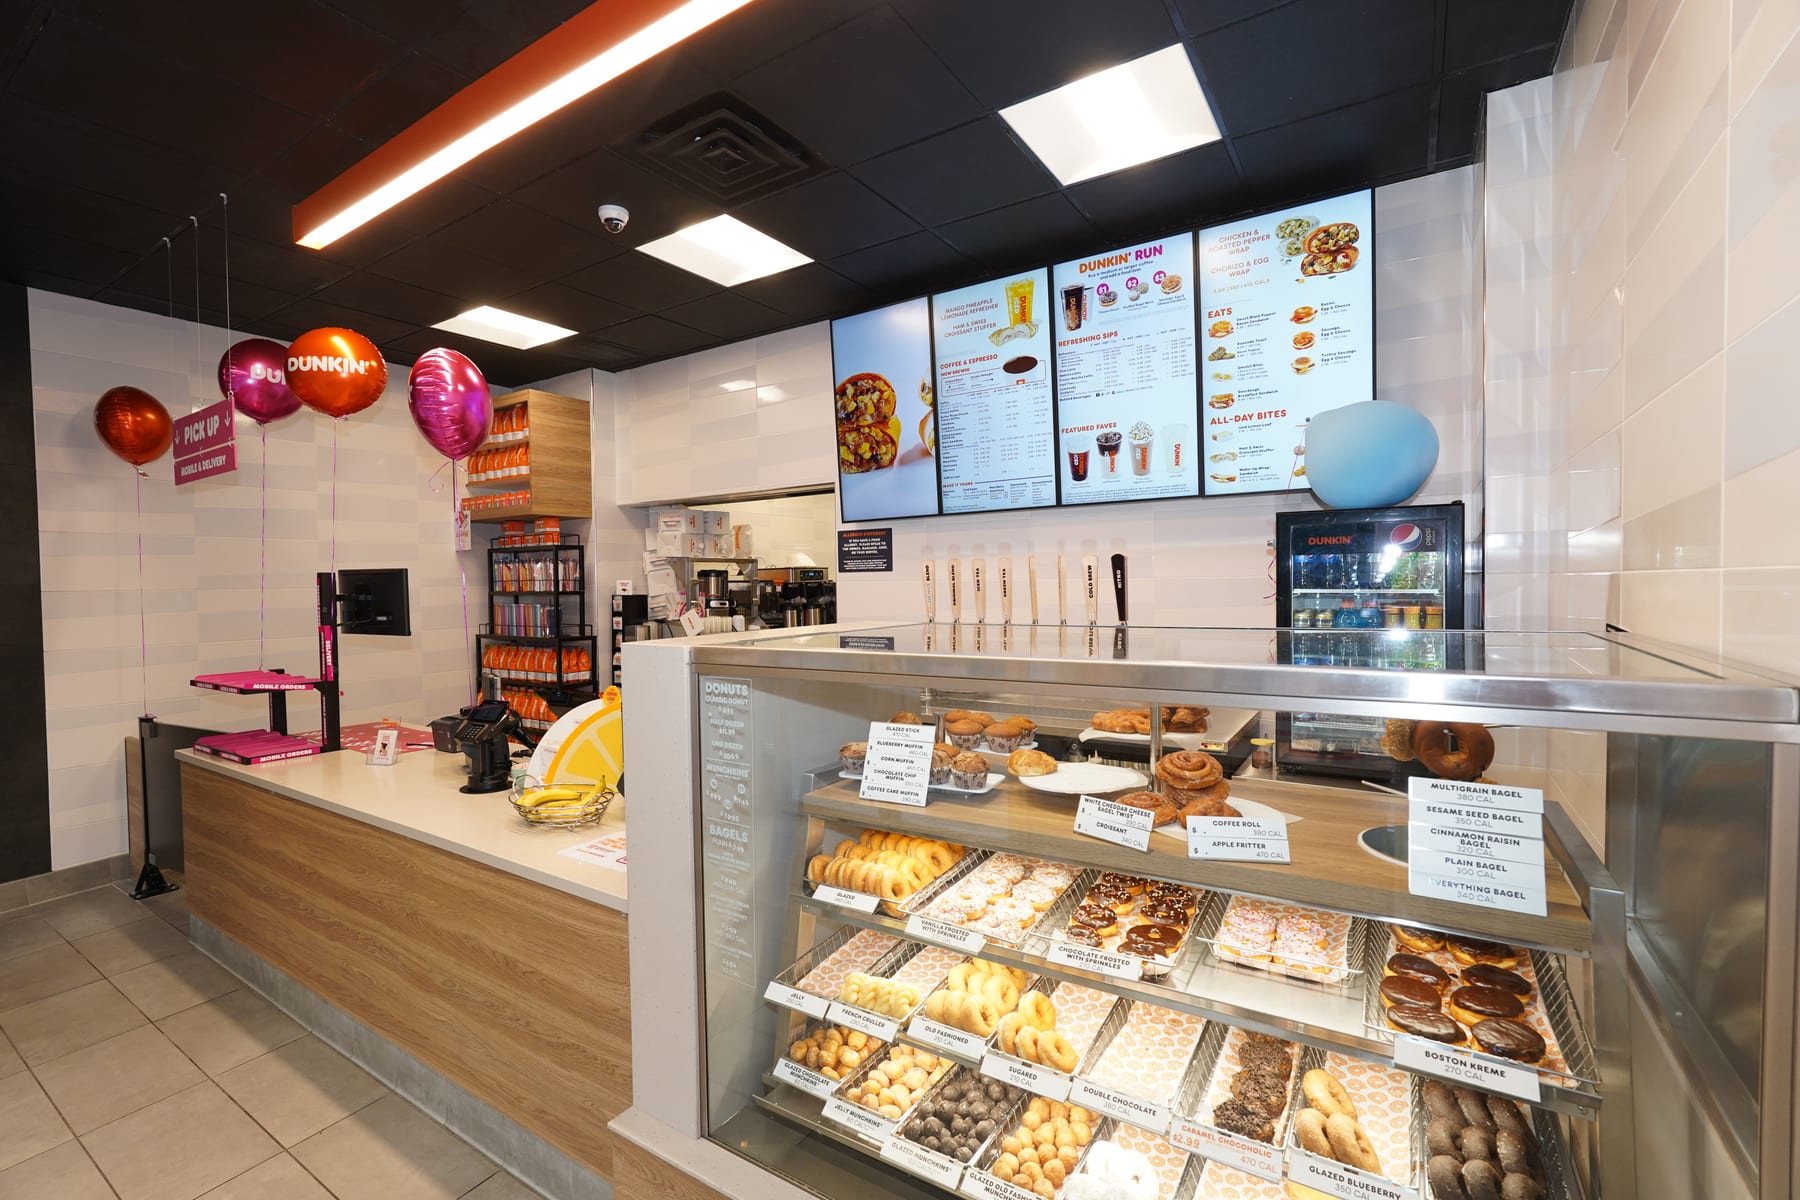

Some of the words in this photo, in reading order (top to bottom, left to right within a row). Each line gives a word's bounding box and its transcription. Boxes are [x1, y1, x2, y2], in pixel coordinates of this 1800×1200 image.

[1208, 240, 1242, 253] ROASTED
[1244, 234, 1270, 246] PEPPER
[1219, 230, 1252, 243] CHICKEN
[1079, 252, 1132, 274] DUNKIN'
[1135, 244, 1163, 261] RUN
[1228, 246, 1250, 256] WRAP
[1210, 262, 1244, 274] CHORIZO
[1253, 256, 1270, 265] EGG
[1229, 269, 1250, 278] WRAP
[940, 311, 969, 321] LEMONADE
[969, 303, 998, 314] REFRESHER
[945, 305, 965, 314] MANGO
[966, 298, 993, 309] PINEAPPLE
[1207, 307, 1233, 319] EATS
[944, 327, 973, 338] CROISSANT
[974, 322, 997, 332] STUFFER
[971, 318, 987, 326] SWISS
[1058, 334, 1101, 347] REFRESHING
[1103, 331, 1119, 339] SIPS
[288, 356, 370, 375] DUNKIN'
[940, 361, 961, 370] COFFEE
[969, 354, 998, 364] ESPRESSO
[1210, 413, 1255, 426] ALL-DAY
[1257, 409, 1287, 420] BITES
[184, 423, 205, 446] PICK
[206, 414, 220, 439] UP
[1061, 425, 1095, 434] FEATURED
[1096, 422, 1117, 430] FAVES
[181, 461, 198, 477] MOBILE
[202, 454, 227, 472] DELIVERY
[1308, 535, 1353, 546] DUNKIN'
[705, 682, 748, 696] DONUTS
[705, 696, 727, 704] CLASSIC
[726, 720, 745, 728] DOZEN
[724, 742, 744, 750] DOZEN
[260, 751, 285, 762] MOBILE
[286, 748, 312, 758] ORDERS
[1431, 783, 1489, 794] MULTIGRAIN
[1492, 789, 1523, 798] BAGEL
[1476, 795, 1495, 804] CAL
[1098, 807, 1114, 815] BAGEL
[1116, 811, 1133, 819] TWIST
[1102, 801, 1128, 812] CHEDDAR
[1129, 808, 1150, 818] CHEESE
[1426, 806, 1462, 816] SESAME
[1466, 810, 1489, 819] SEED
[1492, 814, 1524, 823] BAGEL
[709, 824, 748, 842] BAGELS
[1096, 822, 1128, 834] CROISSANT
[1431, 828, 1485, 840] CINNAMON
[1488, 835, 1520, 846] RAISIN
[1460, 839, 1491, 849] BAGEL
[1476, 848, 1495, 857] CAL
[1445, 857, 1473, 866] PLAIN
[1476, 862, 1508, 872] BAGEL
[1456, 867, 1474, 875] 300
[1476, 870, 1496, 879] CAL
[1456, 891, 1474, 900] 340
[1477, 895, 1496, 904] CAL
[1494, 889, 1526, 900] BAGEL
[921, 920, 944, 930] VANILLA
[945, 926, 970, 937] FROSTED
[922, 925, 936, 934] WITH
[937, 929, 966, 942] SPRINKLES
[1058, 946, 1098, 959] CHOCOLATE
[1100, 955, 1130, 966] FROSTED
[1066, 954, 1084, 962] WITH
[1085, 957, 1121, 970] SPRINKLES
[791, 992, 805, 1001] JELLY
[842, 1008, 862, 1020] FRENCH
[862, 1015, 885, 1028] CRULLER
[925, 1025, 936, 1034] OLD
[936, 1029, 969, 1044] FASHIONED
[1425, 1050, 1467, 1067] BOSTON
[1470, 1063, 1506, 1078] KREME
[784, 1062, 801, 1074] GLAZED
[801, 1069, 830, 1086] CHOCOLATE
[1008, 1065, 1038, 1081] SUGARED
[1444, 1065, 1462, 1075] 270
[1464, 1070, 1485, 1082] CAL
[834, 1104, 849, 1114] JELLY
[1083, 1085, 1111, 1100] DOUBLE
[1112, 1096, 1157, 1117] CHOCOLATE
[892, 1142, 913, 1156] GLAZED
[1173, 1133, 1200, 1149] $2.99
[1181, 1124, 1216, 1142] CARAMEL
[1218, 1136, 1272, 1158] CHOCOHOLIC
[1240, 1155, 1258, 1167] 470
[1259, 1160, 1278, 1174] CAL
[969, 1173, 994, 1187] GLAZED
[995, 1183, 1008, 1193] OLD
[1309, 1165, 1345, 1183] GLAZED
[1347, 1178, 1402, 1200] BLUEBERRY
